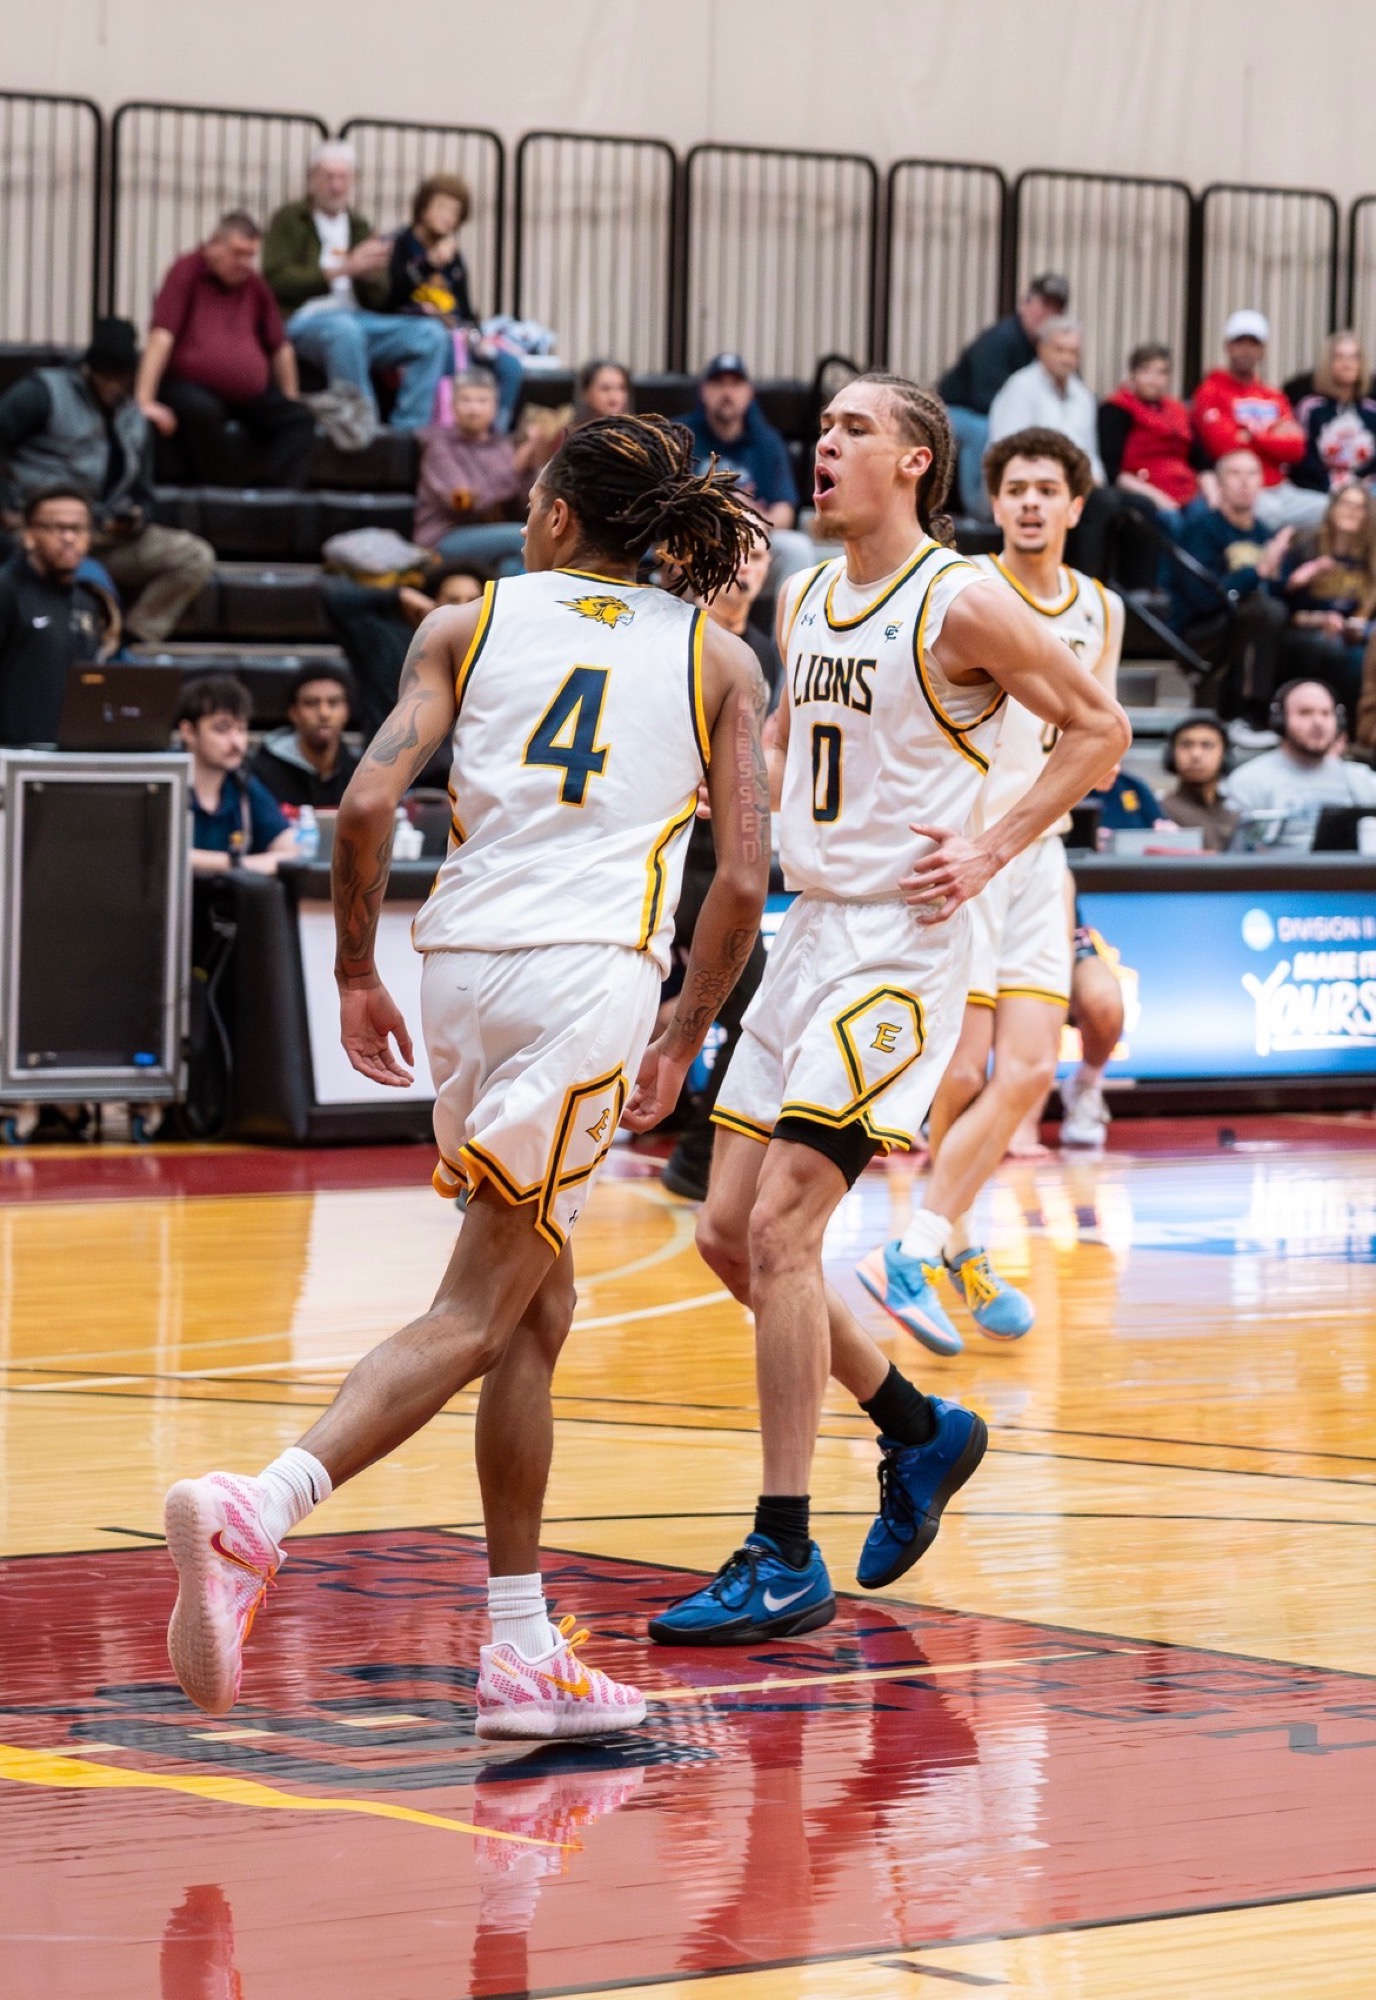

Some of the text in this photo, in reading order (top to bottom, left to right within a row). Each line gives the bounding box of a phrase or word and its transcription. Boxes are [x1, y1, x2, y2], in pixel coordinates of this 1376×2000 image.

[794, 653, 877, 715] LIONS
[520, 664, 611, 808] 4
[811, 721, 843, 824] 0
[1277, 916, 1361, 942] DIVISION
[1293, 951, 1358, 981] MAKE
[870, 1022, 903, 1053] E
